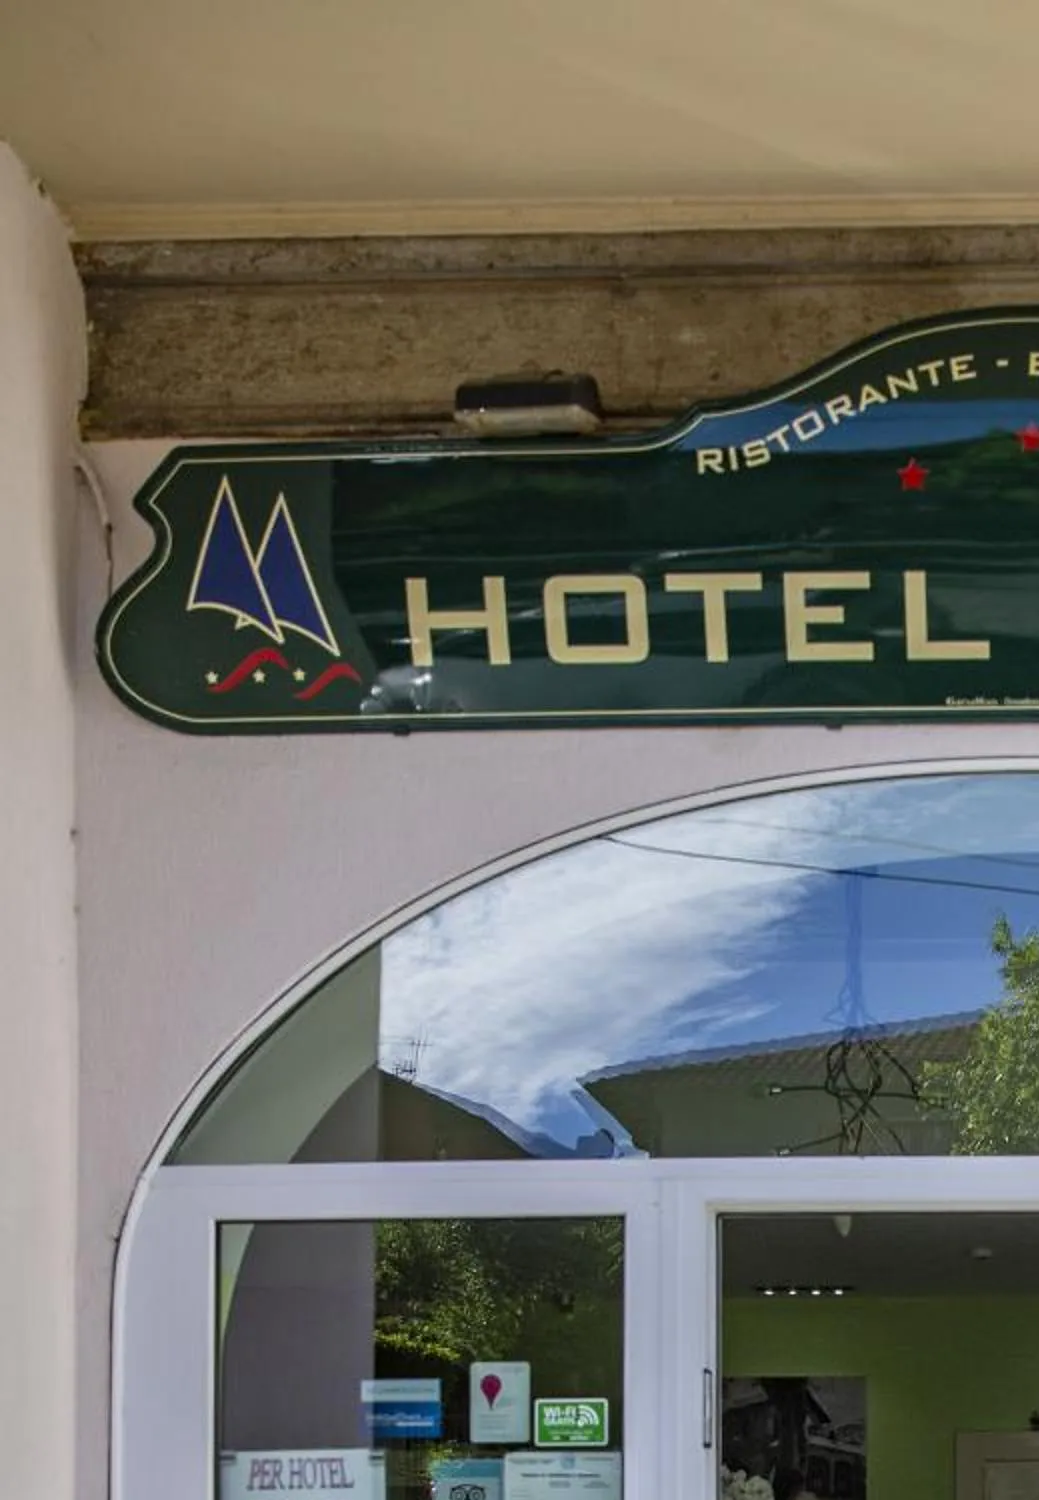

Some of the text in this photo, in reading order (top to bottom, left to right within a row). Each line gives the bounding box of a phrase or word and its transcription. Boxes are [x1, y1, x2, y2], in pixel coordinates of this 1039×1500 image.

[697, 354, 976, 474] RISTORANTE
[405, 571, 990, 665] HOTEL
[247, 1457, 354, 1491] PER HOTEL
